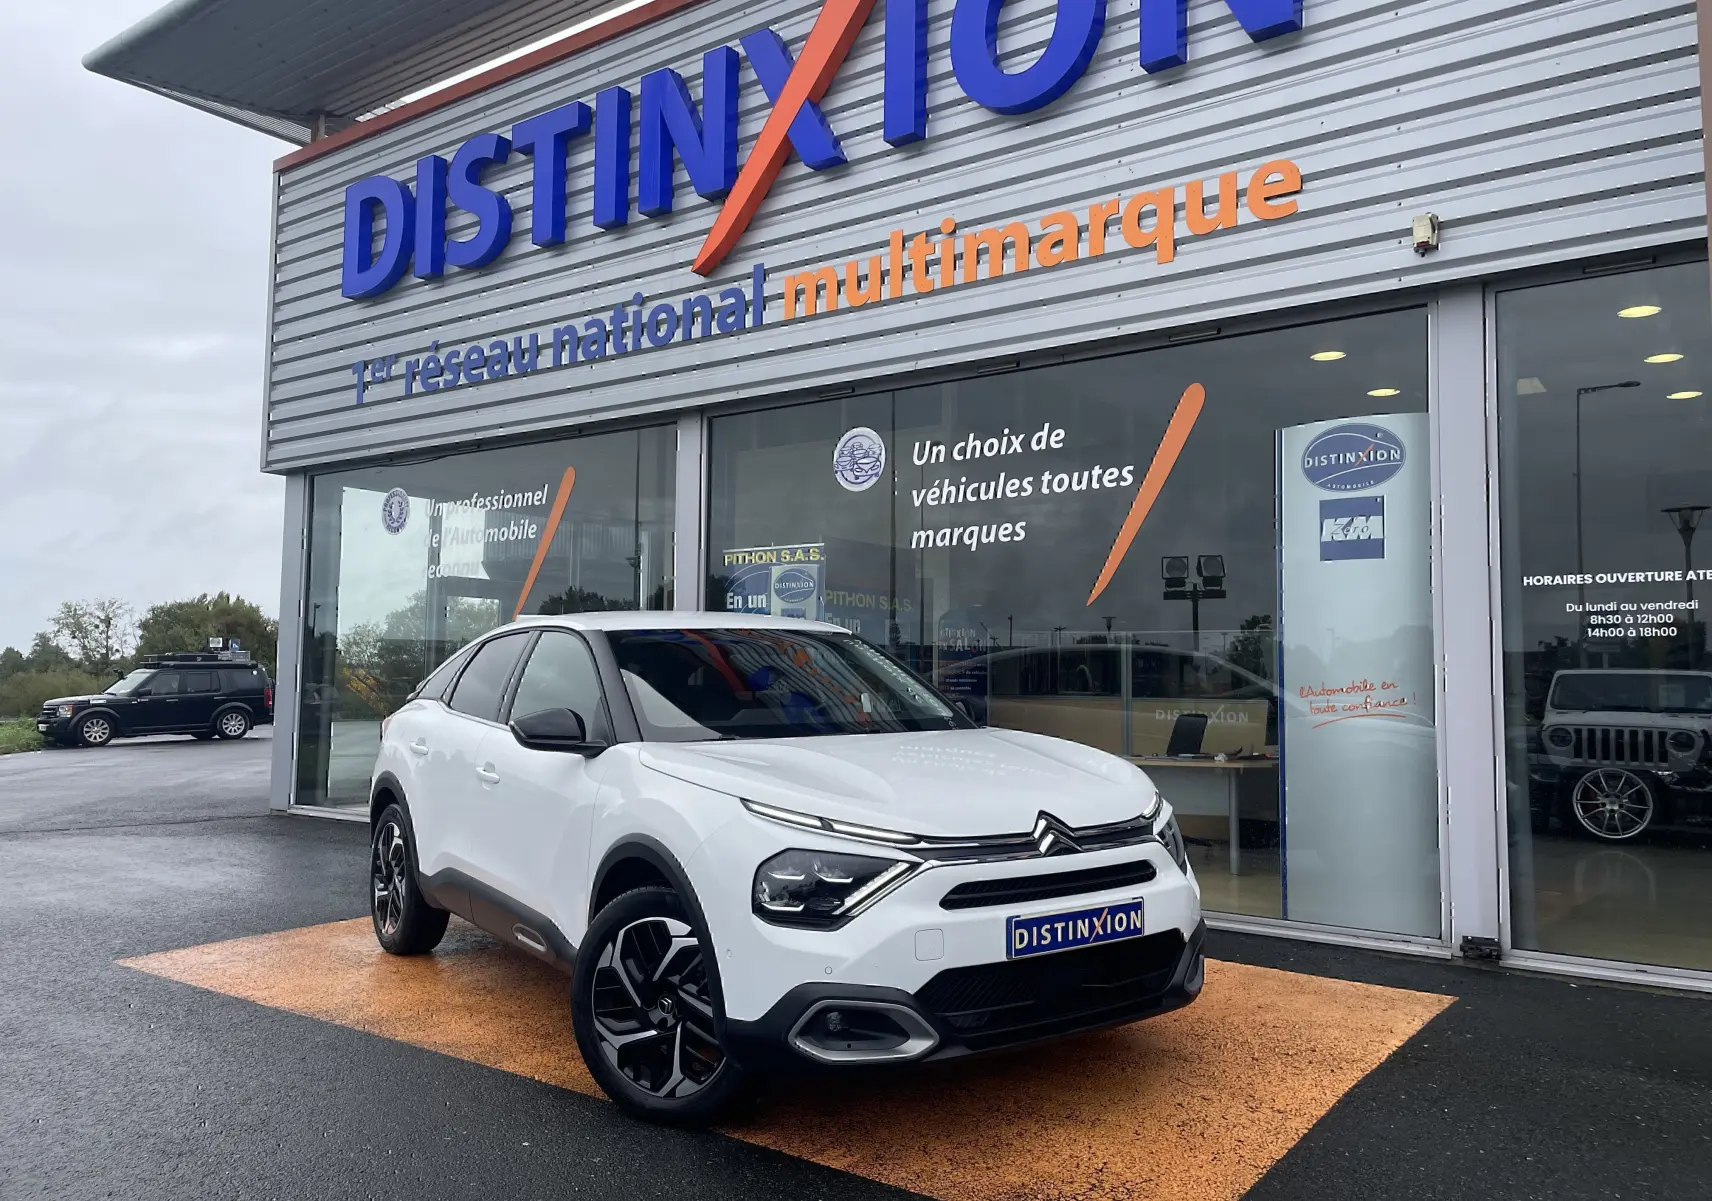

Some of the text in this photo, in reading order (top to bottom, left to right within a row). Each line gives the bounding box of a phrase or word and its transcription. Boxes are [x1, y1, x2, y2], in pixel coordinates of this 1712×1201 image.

[341, 0, 1302, 300] DISTINXIO
[351, 158, 1303, 405] 1er réseau national multimarque
[911, 421, 1067, 467] Un choix de
[1304, 443, 1401, 469] DISTINXION
[911, 463, 1135, 508] véhicules toutes
[424, 483, 549, 521] Un professionnel
[424, 519, 538, 548] de l'Automobile
[911, 518, 1027, 552] marques
[724, 547, 825, 567] PITHON S.A.S.
[1523, 574, 1592, 586] HORAIRES
[1596, 571, 1682, 583] OUVERTURE
[726, 592, 767, 609] En un
[824, 589, 876, 610] PITHON
[1566, 600, 1699, 612] Du lundi au vendredi
[1590, 613, 1674, 625] 8h30 à 12h00
[1587, 626, 1678, 638] 14h00 à 18h00
[1299, 679, 1399, 698] l'Automobile en
[1155, 705, 1249, 724] DISXION
[1309, 699, 1338, 715] toute
[1342, 694, 1408, 713] confiance
[1014, 907, 1142, 950] DISTINXION
